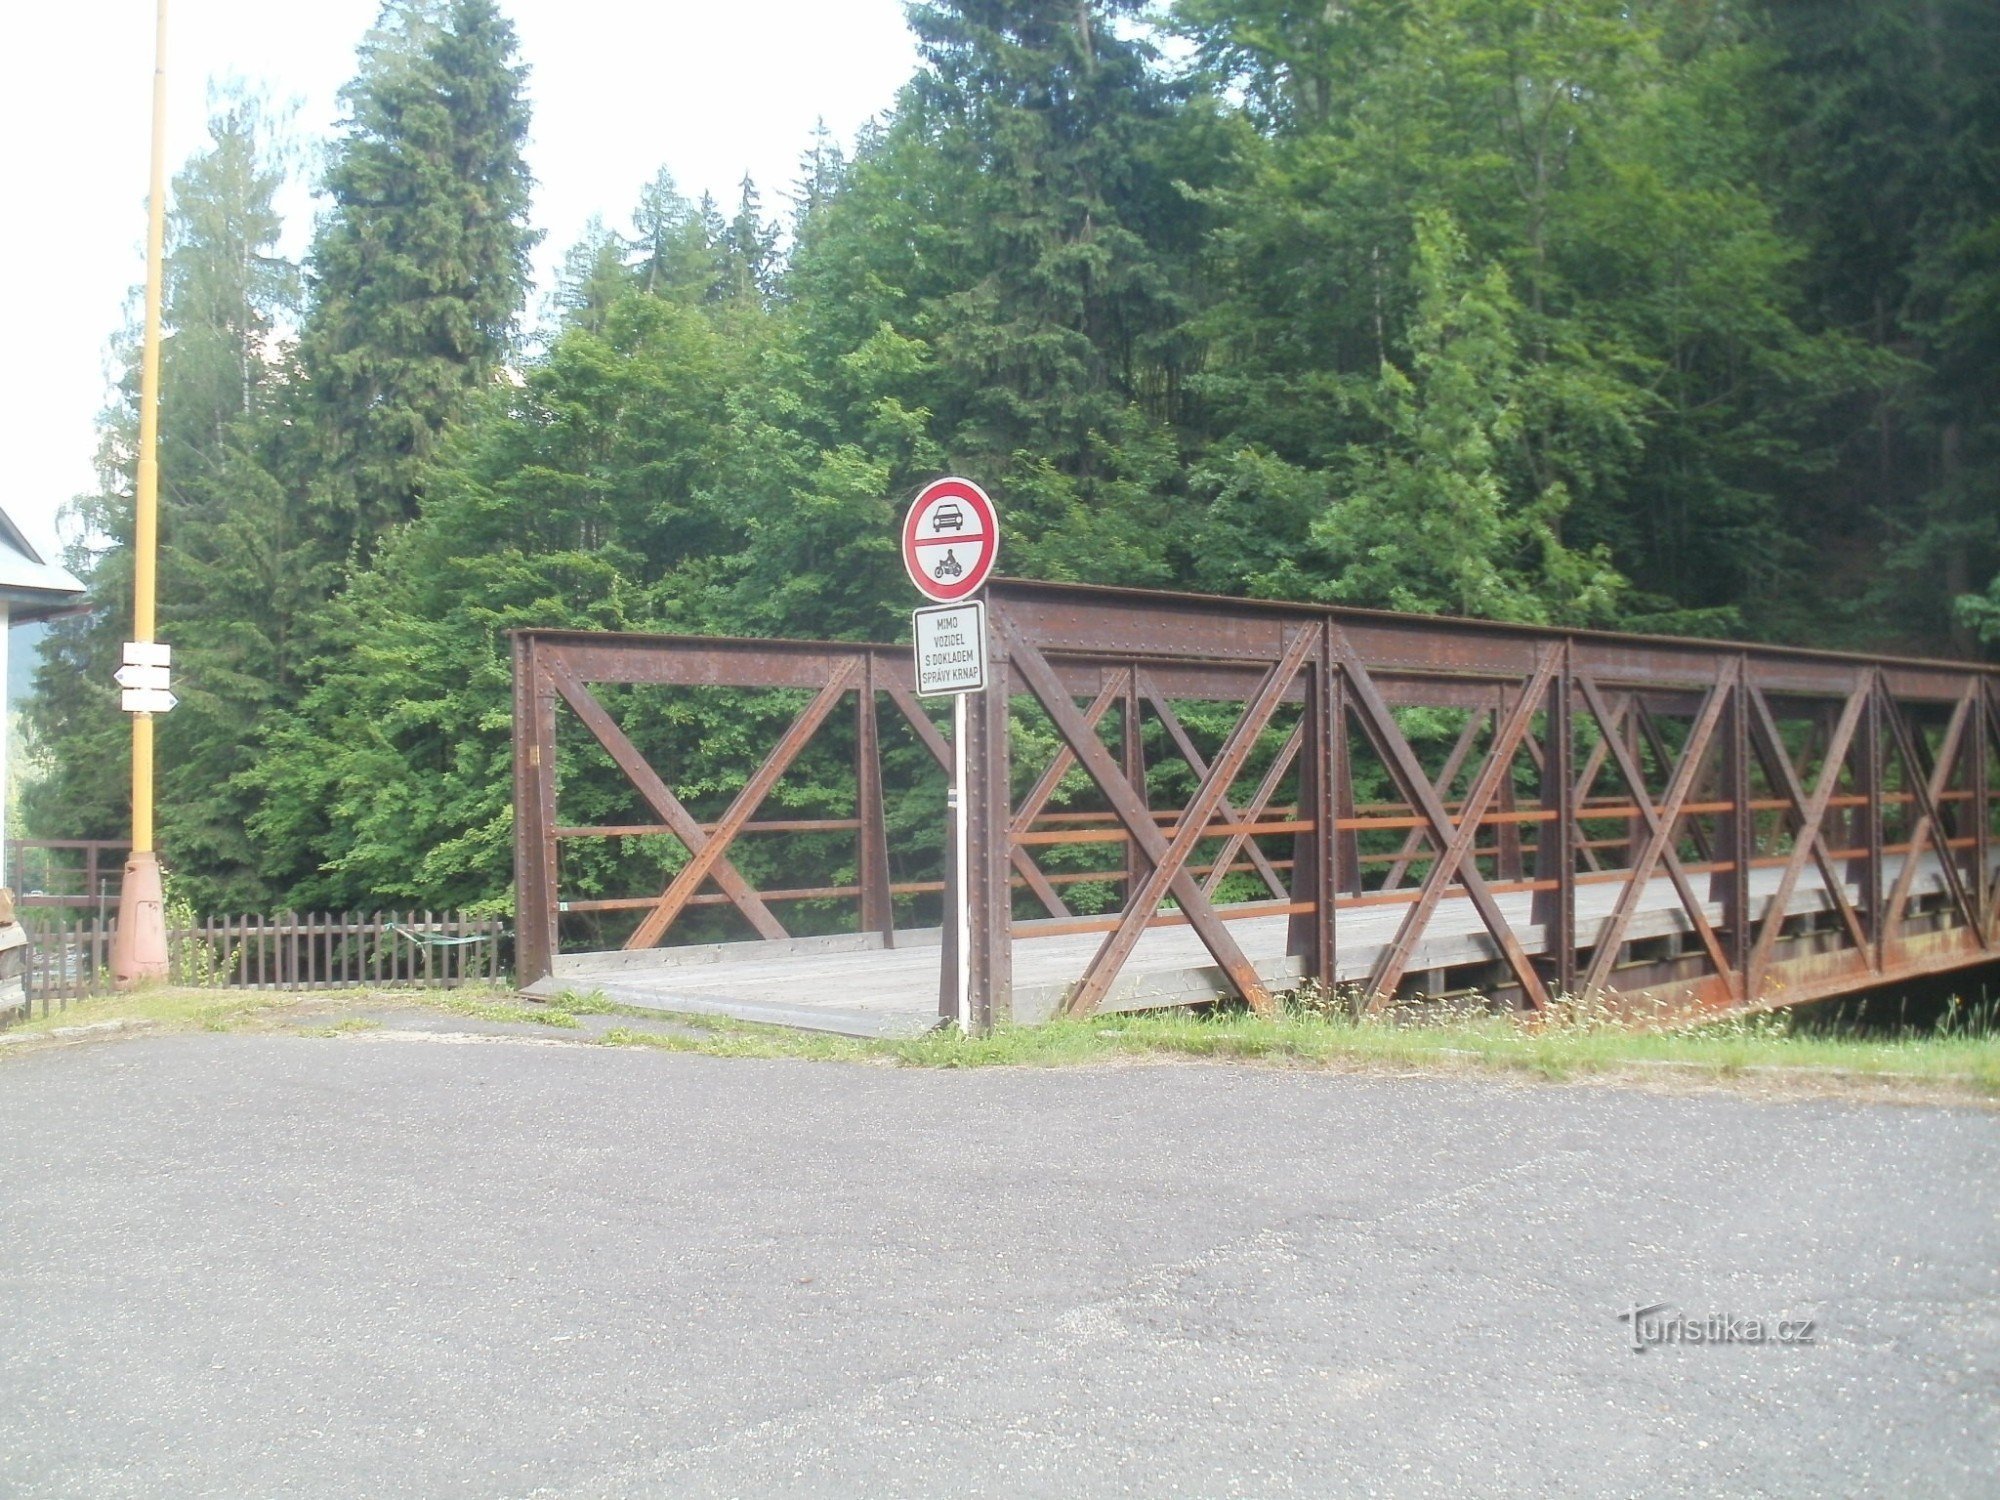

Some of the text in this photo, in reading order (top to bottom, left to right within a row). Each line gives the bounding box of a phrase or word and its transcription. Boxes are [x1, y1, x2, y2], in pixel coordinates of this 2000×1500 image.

[937, 616, 958, 630] MIMO
[934, 633, 965, 648] VOZIDEL
[925, 649, 974, 666] S DOKLADEM
[922, 666, 979, 684] SPRÁVY KRNAP
